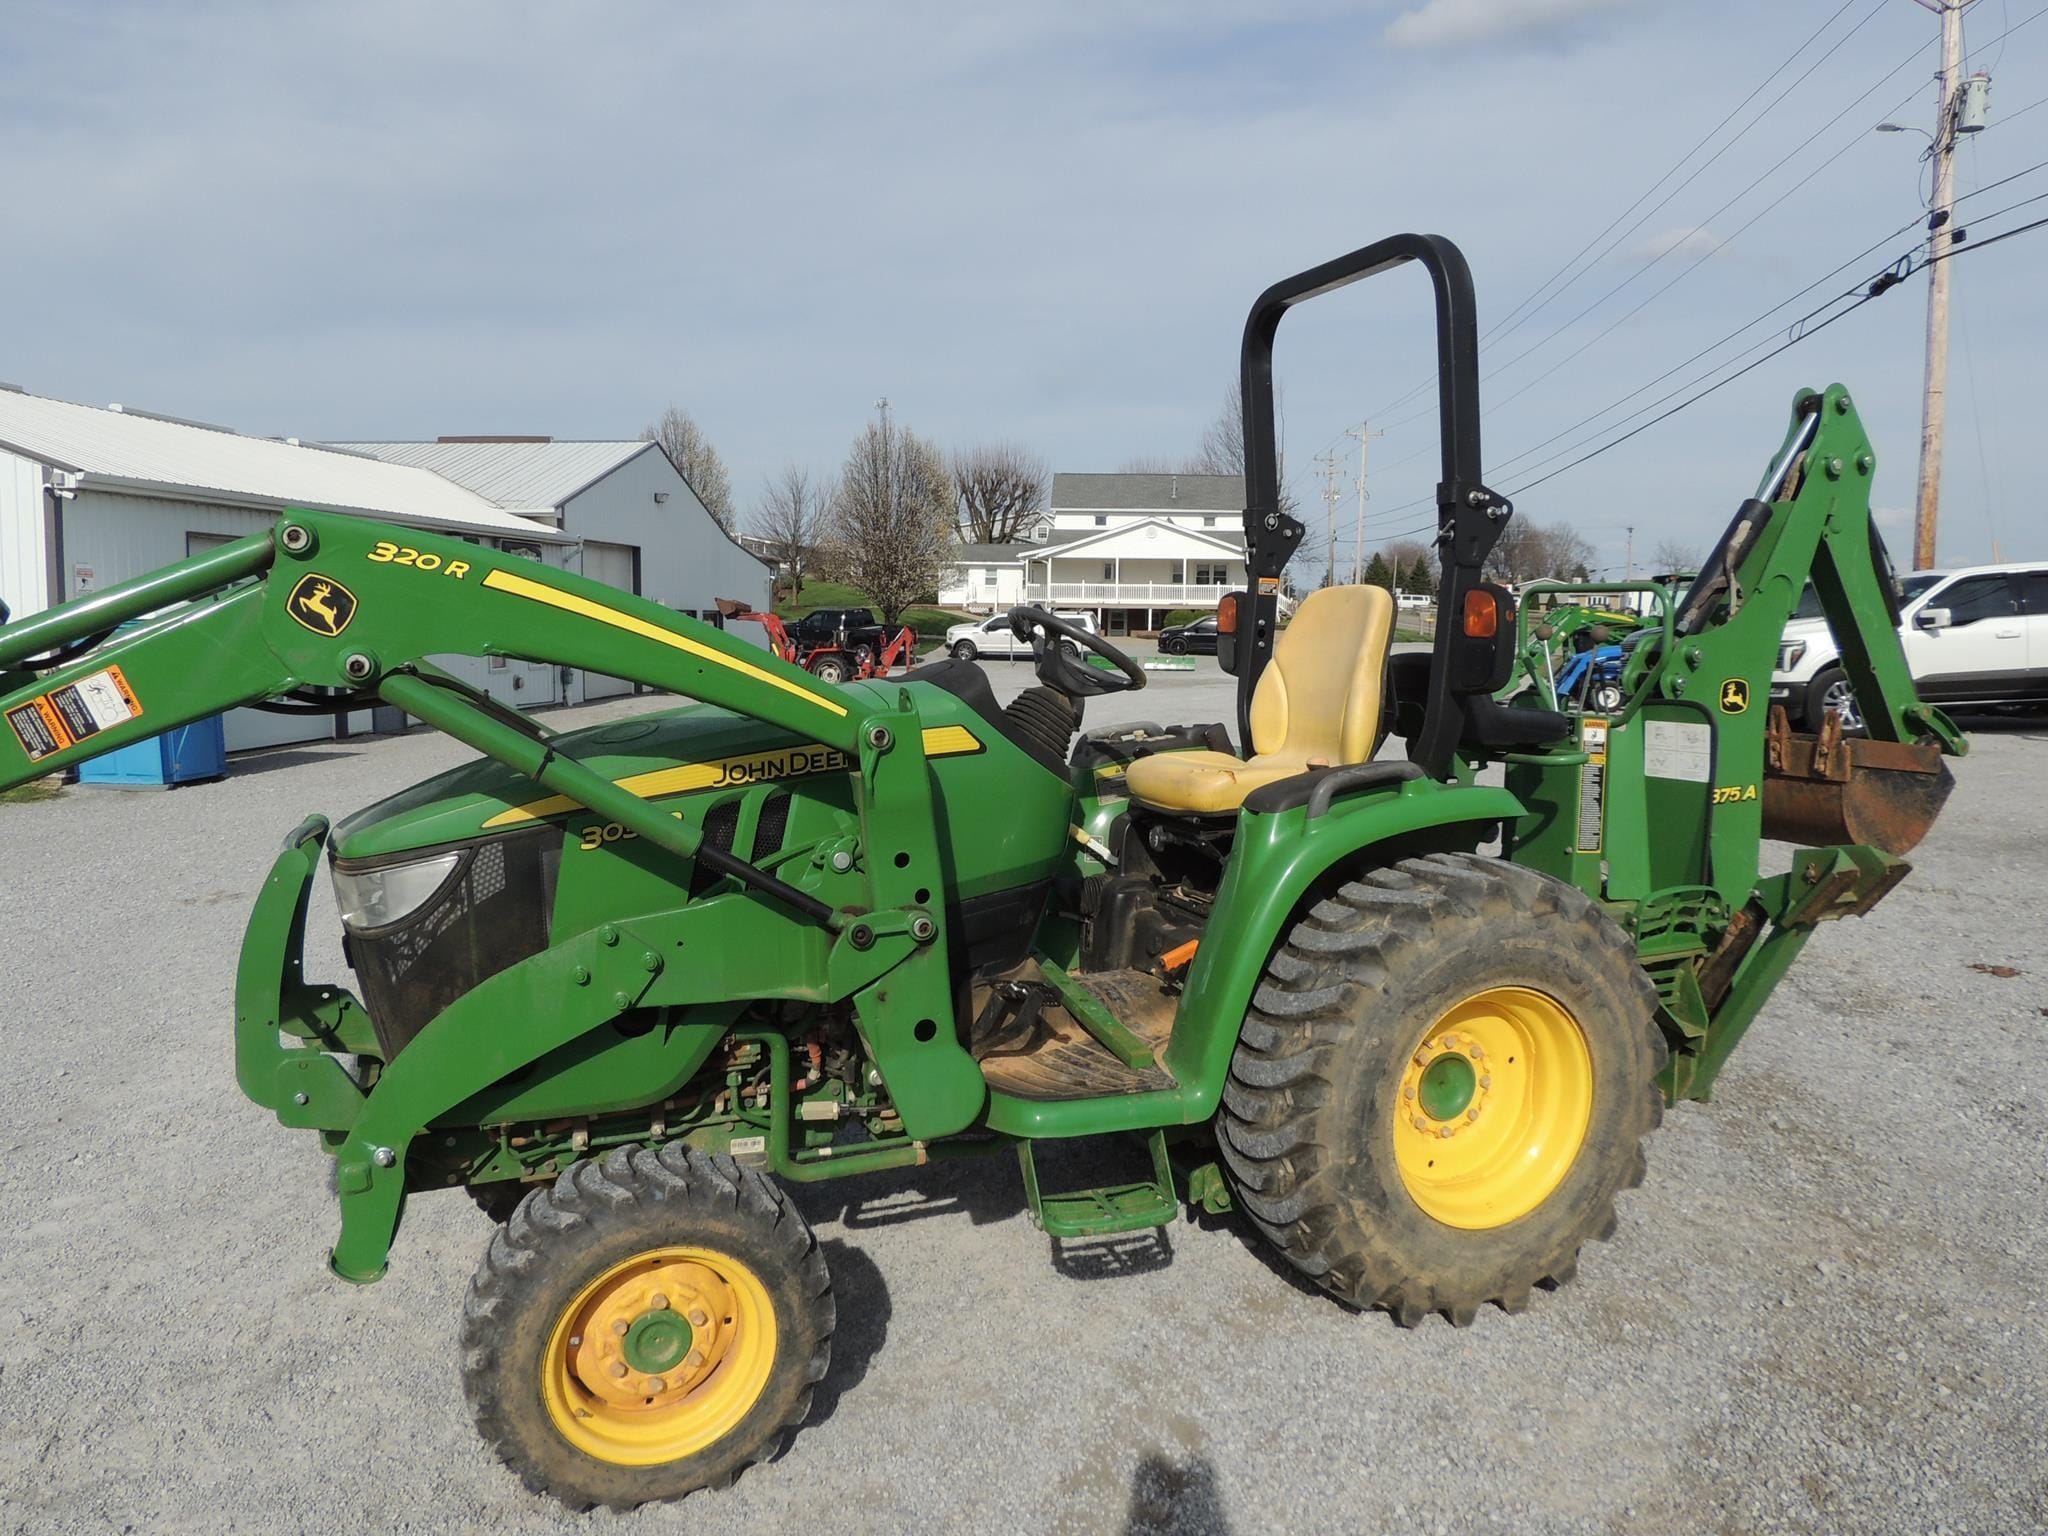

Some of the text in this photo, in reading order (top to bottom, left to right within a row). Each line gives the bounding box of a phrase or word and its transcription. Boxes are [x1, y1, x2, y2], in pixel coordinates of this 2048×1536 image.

[367, 541, 471, 579] 320 R
[44, 711, 65, 744] WARNING
[713, 759, 785, 787] JOHN
[1712, 784, 1756, 803] 375 A
